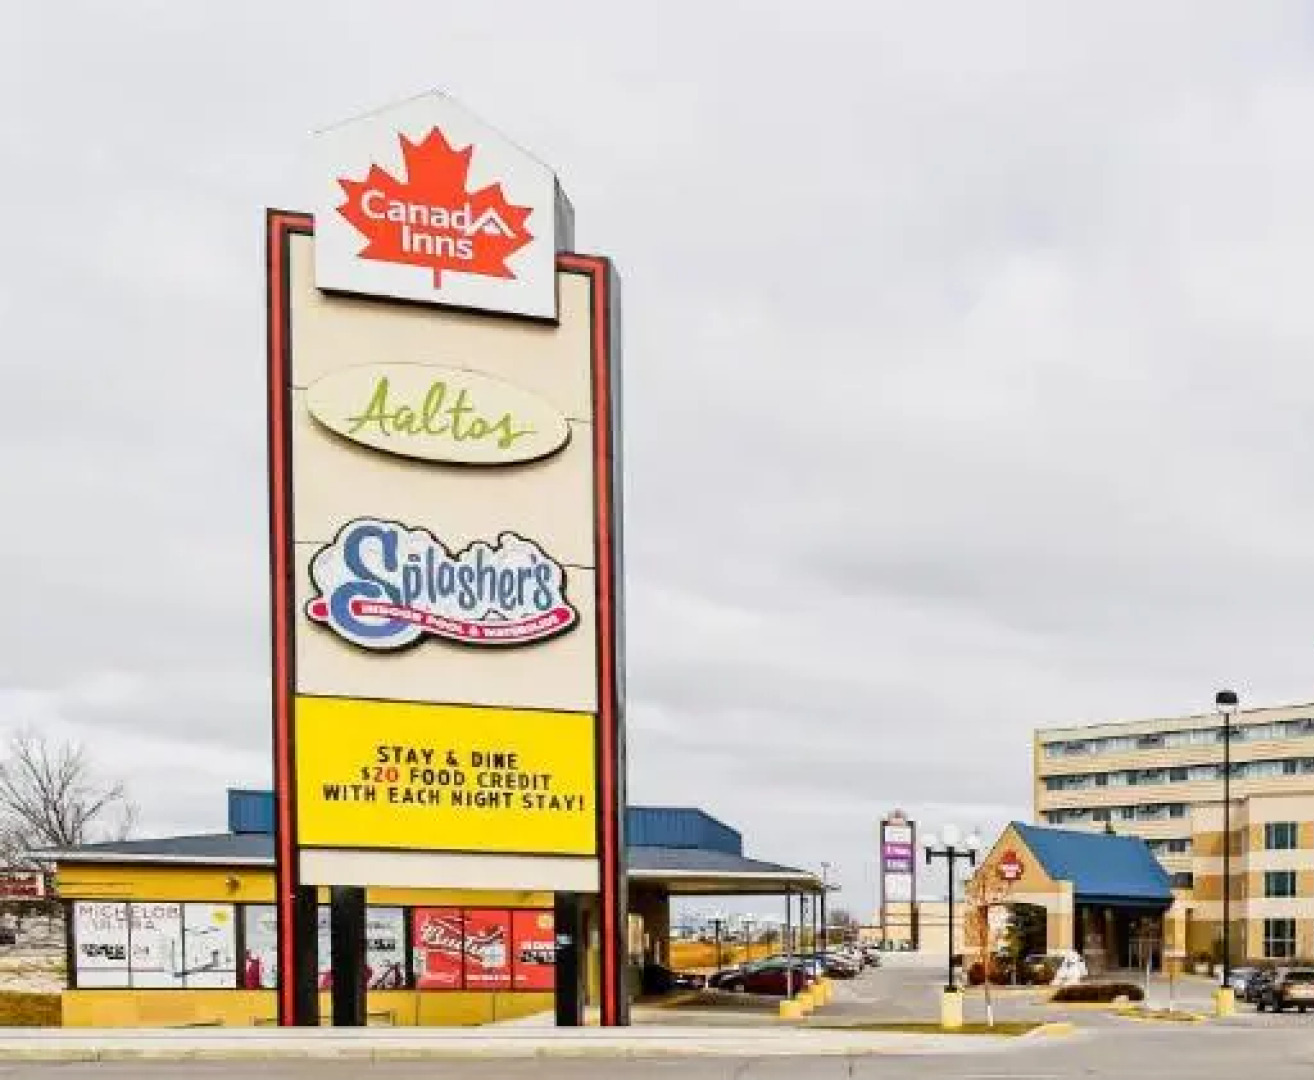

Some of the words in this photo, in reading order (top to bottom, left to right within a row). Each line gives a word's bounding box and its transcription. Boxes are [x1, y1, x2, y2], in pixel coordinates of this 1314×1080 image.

[361, 189, 517, 238] Canada
[402, 224, 473, 260] Inns
[345, 376, 539, 451] Aaltos
[330, 524, 553, 638] Splasher's
[376, 745, 435, 765] STAY
[445, 749, 460, 768] &
[470, 751, 519, 770] DINE
[359, 766, 402, 783] $20
[409, 768, 466, 786] FOOD
[476, 770, 553, 791] CREDIT
[322, 784, 377, 802] WITH
[387, 786, 441, 805] EACH
[450, 789, 515, 809] NIGHT
[521, 792, 587, 812] STAY!
